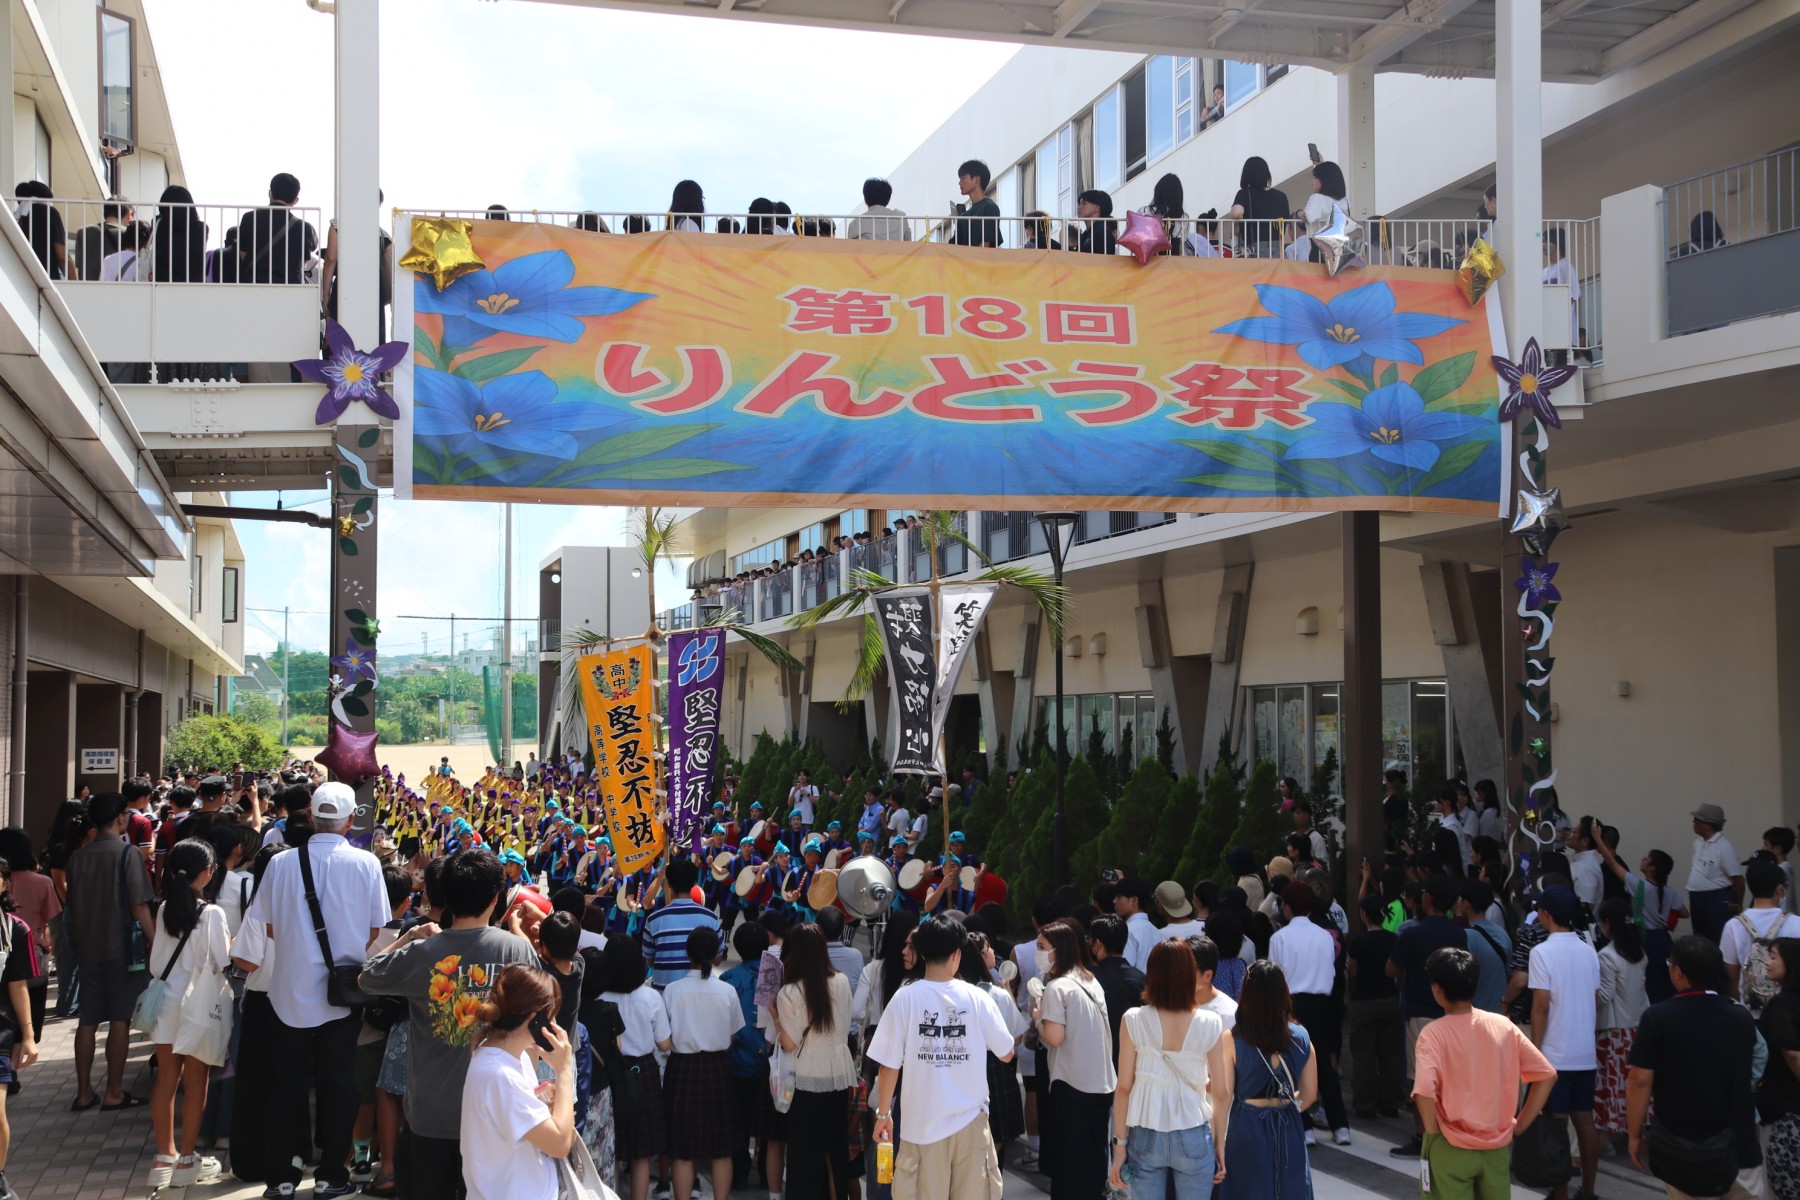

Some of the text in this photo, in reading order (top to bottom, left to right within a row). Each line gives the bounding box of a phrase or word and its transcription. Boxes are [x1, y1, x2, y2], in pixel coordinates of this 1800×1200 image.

[780, 285, 1135, 347] 第18回
[600, 342, 1316, 432] りんどう祭
[609, 663, 626, 689] 高中
[594, 724, 622, 833] 高等学校 中学校
[936, 1053, 970, 1061] BALANCE
